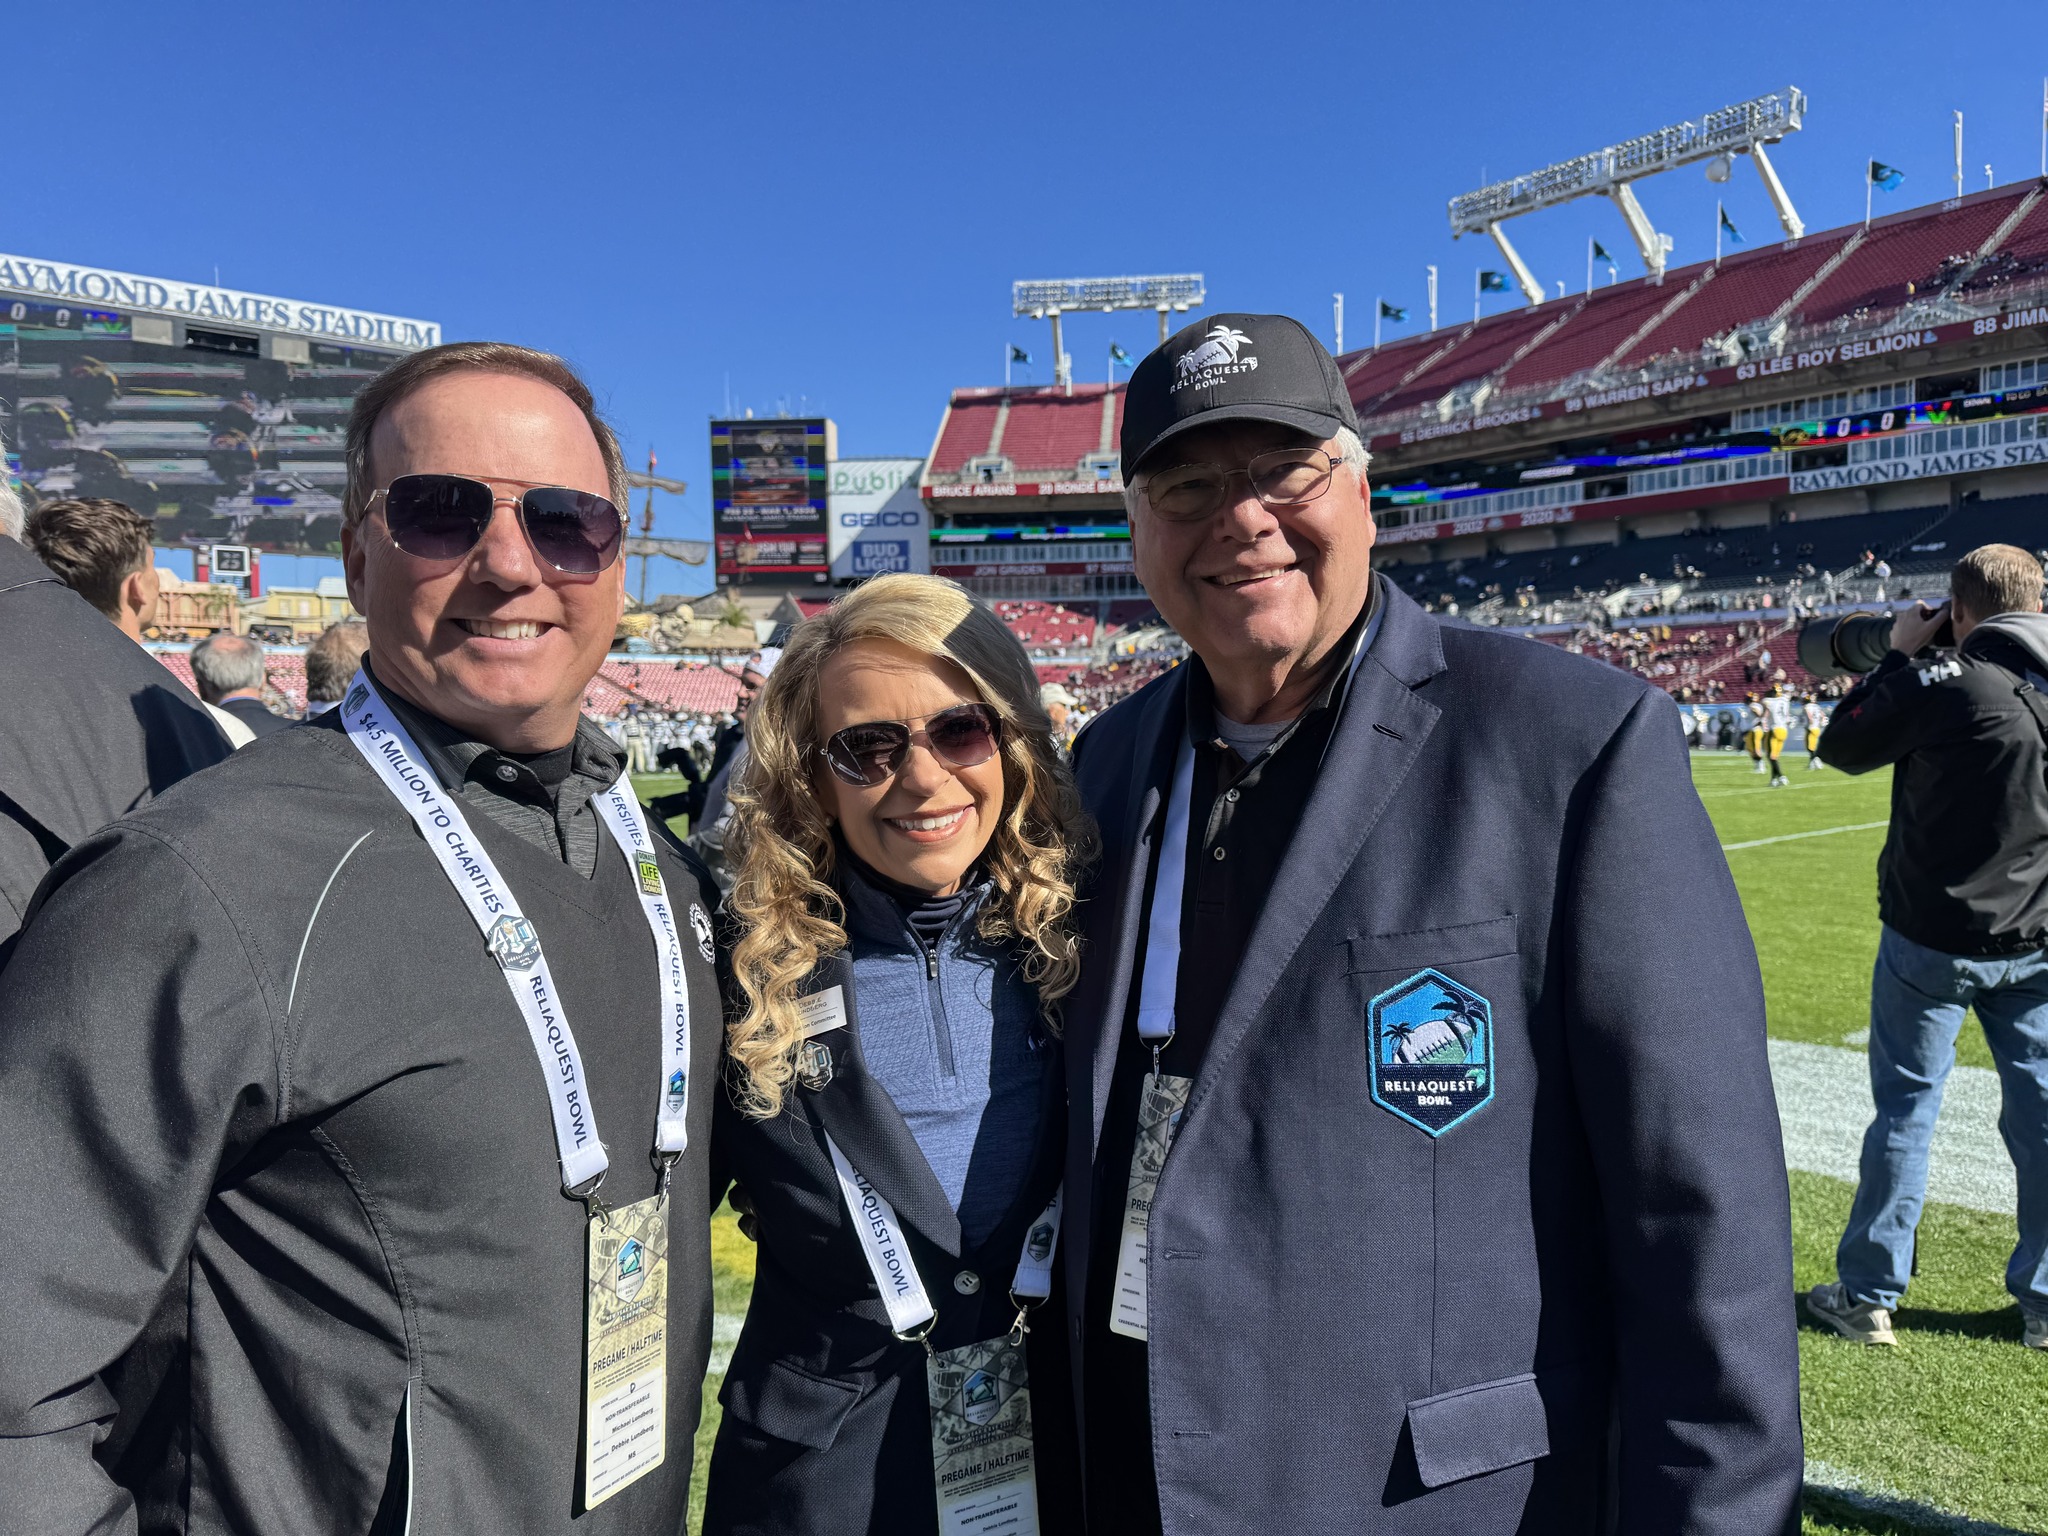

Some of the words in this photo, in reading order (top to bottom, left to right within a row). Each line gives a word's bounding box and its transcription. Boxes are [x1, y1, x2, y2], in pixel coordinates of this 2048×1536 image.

[175, 287, 290, 328] JAMES
[298, 306, 436, 348] STADIUM
[1973, 317, 1997, 335] 88
[1736, 364, 1757, 380] 63
[1760, 355, 1794, 376] LEE
[1797, 346, 1837, 368] ROY
[1840, 331, 1921, 361] SELMON
[1169, 365, 1248, 395] RELIAQUEST
[1194, 376, 1227, 391] BOWL
[1584, 384, 1650, 409] WARREN
[1652, 374, 1695, 397] SAPP
[1472, 407, 1531, 430] BROOKS
[1836, 417, 1851, 438] 0
[1880, 412, 1895, 431] 0
[1792, 461, 1910, 492] RAYMOND
[1913, 449, 1997, 477] JAMES
[932, 484, 973, 497] BRUCE
[841, 511, 919, 528] GEICO
[862, 543, 900, 557] BUD
[855, 556, 907, 571] LIGHT
[359, 713, 387, 741] $4.5
[379, 740, 436, 804] MILLION
[428, 805, 451, 828] TO
[445, 831, 505, 914] CHARITIES
[641, 864, 658, 878] LIFE
[654, 903, 684, 998] RELIAQUEST
[675, 1002, 685, 1056] BOWL
[529, 975, 576, 1085] RELIAQUEST
[566, 1089, 588, 1149] BOWL
[1384, 1081, 1475, 1092] RELIAQUEST
[1417, 1095, 1452, 1106] BOWL
[882, 1248, 910, 1297] BOWL
[593, 1347, 626, 1374] PREGAME
[626, 1344, 630, 1357] /
[630, 1329, 662, 1355] HALFTIME
[605, 1393, 650, 1422] NON-TRANSFERABLE
[611, 1418, 632, 1434] Michael
[632, 1407, 654, 1423] Lundberg
[611, 1438, 630, 1452] Debbie
[630, 1424, 655, 1441] Lundberg
[628, 1450, 637, 1460] MS
[941, 1463, 982, 1485] PREGAME
[983, 1461, 988, 1472] /
[988, 1448, 1030, 1471] HALFTIME
[961, 1502, 1018, 1526] NON-TRANSFERABLE
